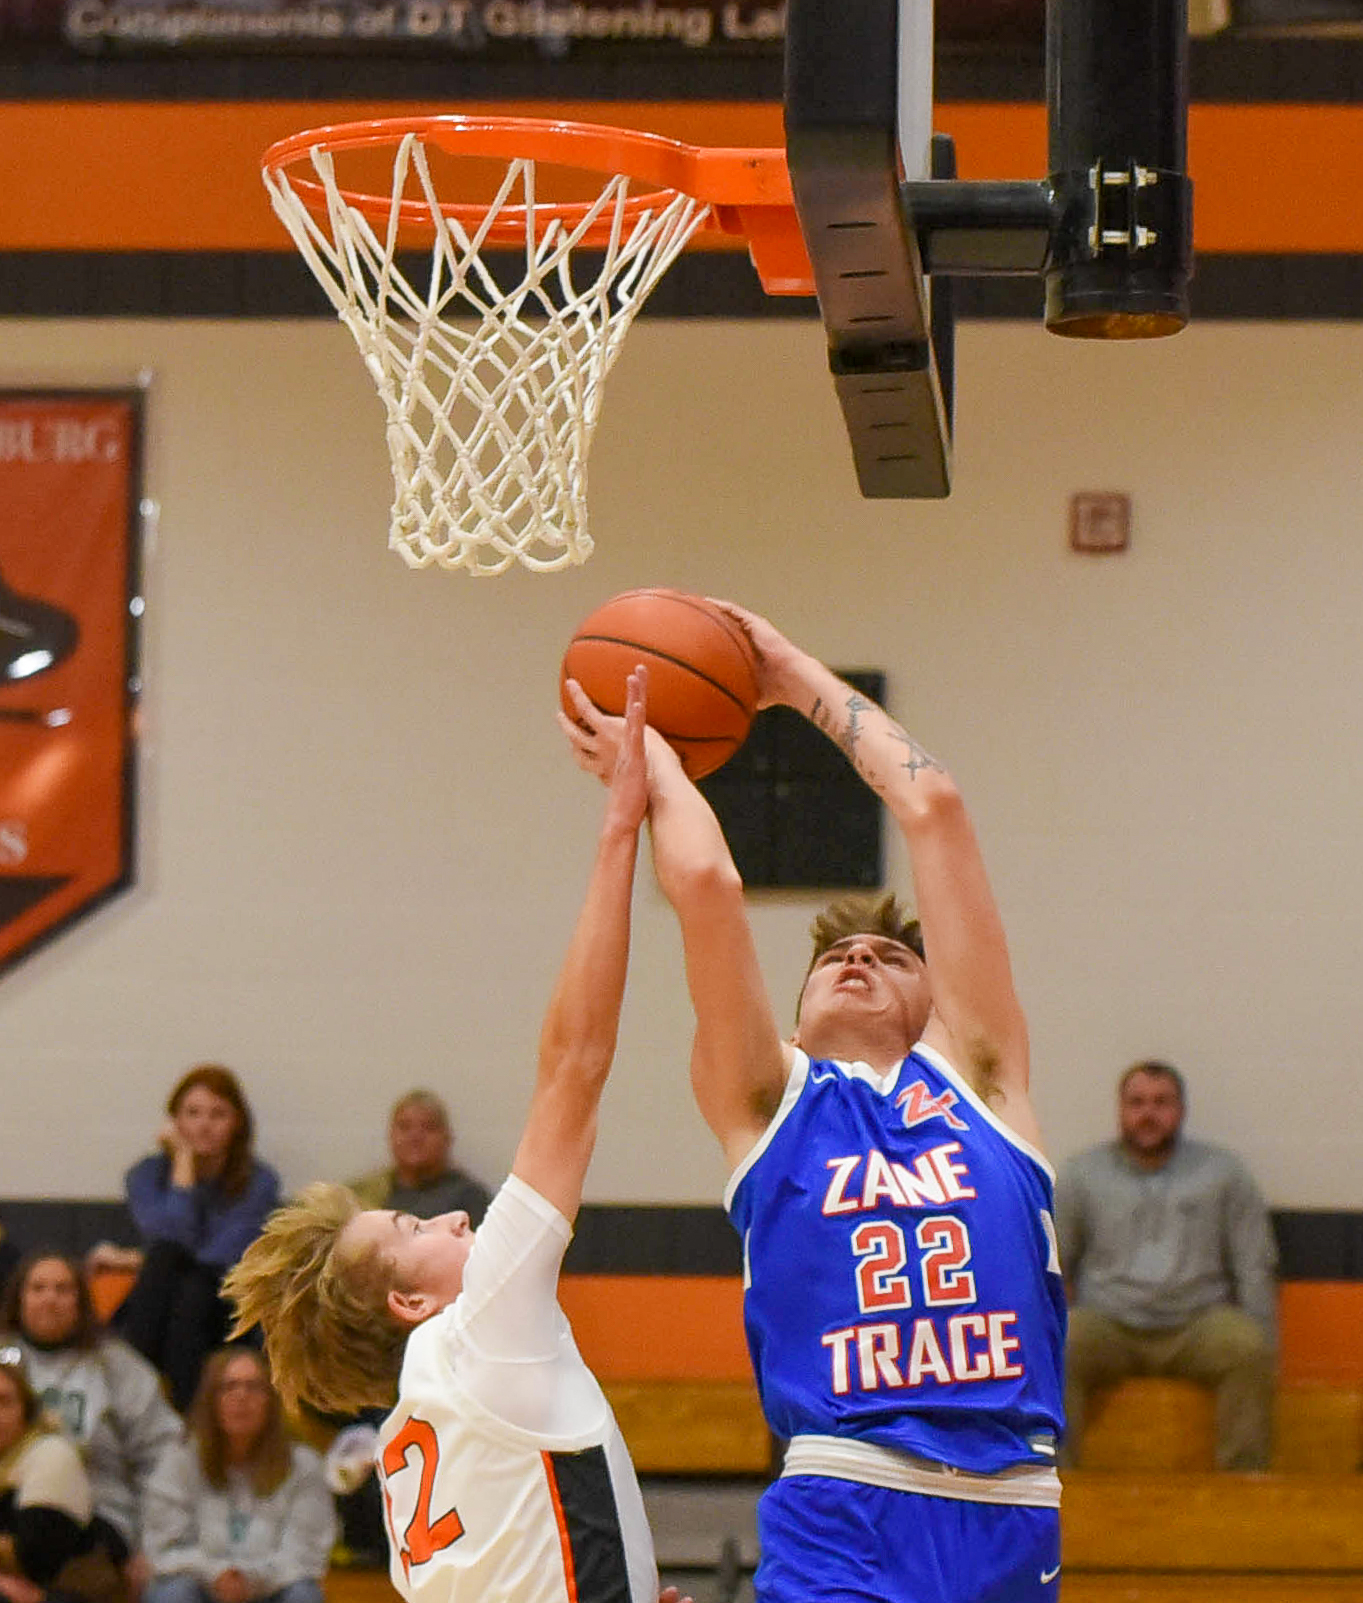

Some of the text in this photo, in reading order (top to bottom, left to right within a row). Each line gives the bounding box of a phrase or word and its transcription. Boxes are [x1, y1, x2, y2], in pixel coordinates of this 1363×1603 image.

[822, 1142, 977, 1216] ZANE
[851, 1215, 977, 1315] 22
[821, 1311, 1024, 1395] TRACE
